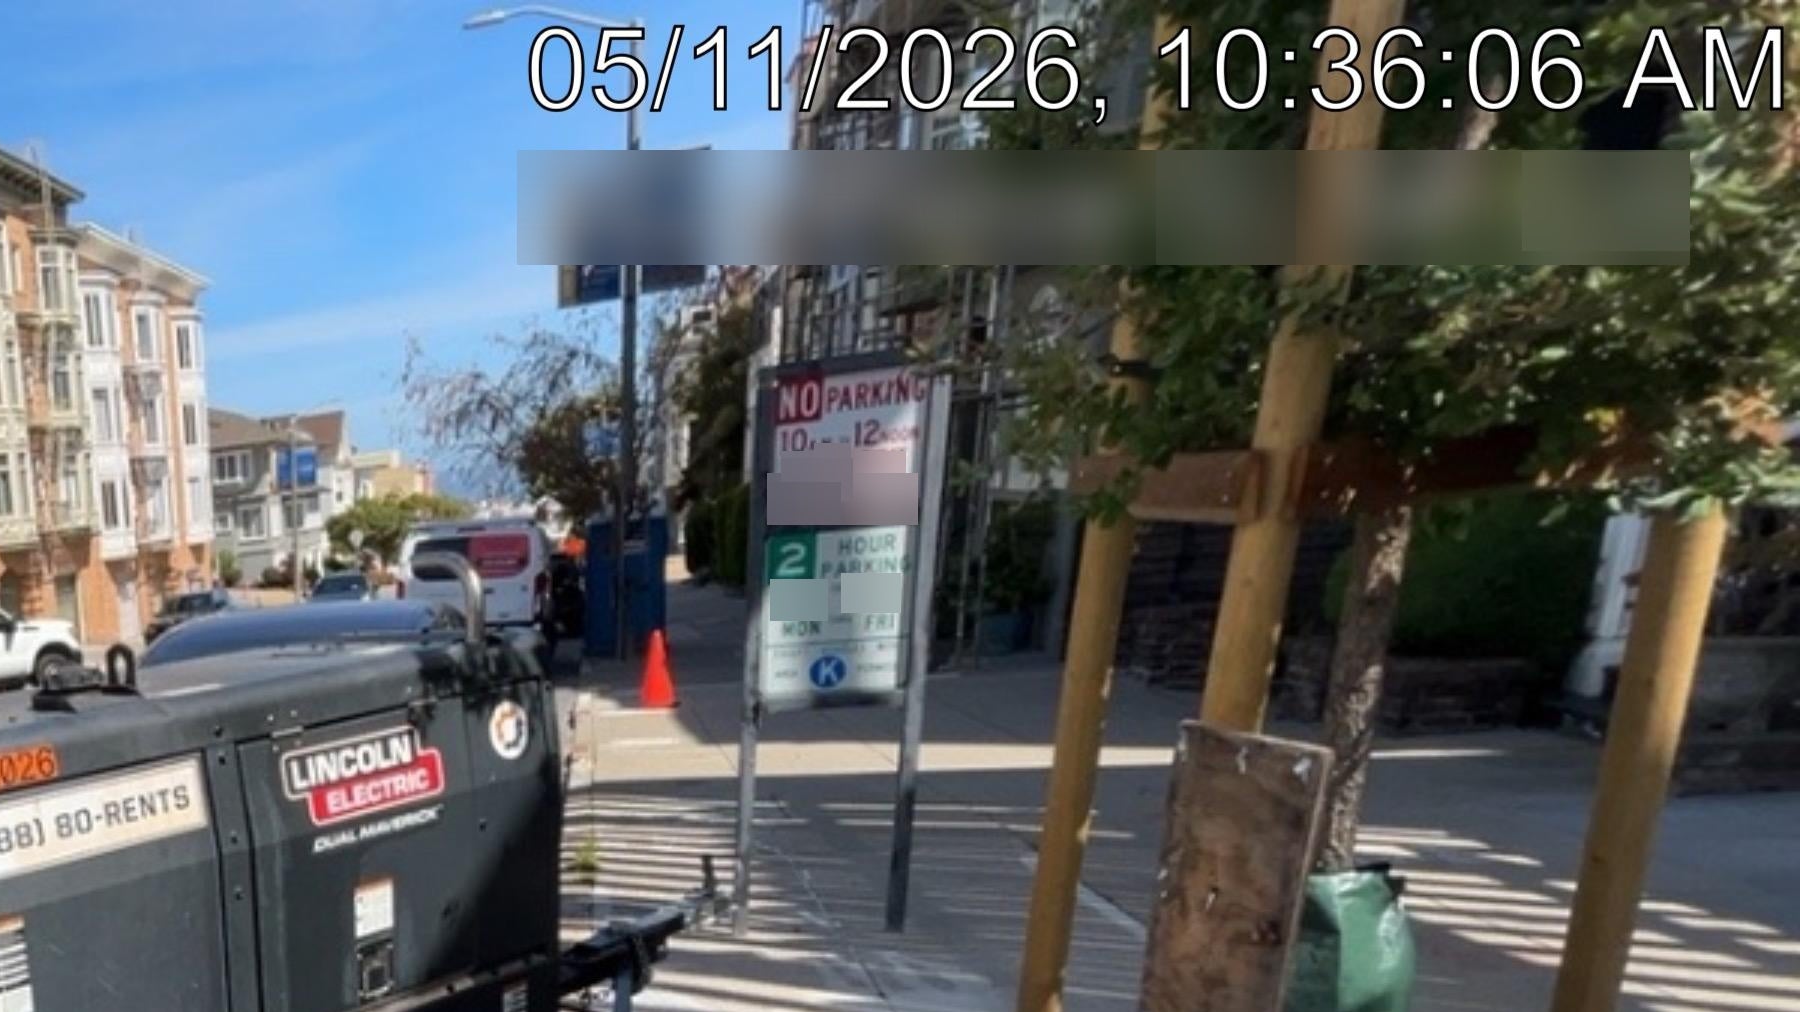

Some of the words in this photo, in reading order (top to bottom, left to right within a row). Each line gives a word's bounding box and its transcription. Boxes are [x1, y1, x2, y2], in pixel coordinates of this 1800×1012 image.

[778, 380, 820, 421] NO
[827, 372, 926, 412] PARKING
[776, 541, 806, 577] 2
[838, 533, 896, 556] HOUR
[822, 554, 912, 578] PARKING
[783, 620, 821, 637] MON
[865, 614, 895, 631] FRI
[818, 656, 838, 685] K
[290, 733, 413, 790] LINCOLN
[54, 783, 191, 841] 80-RENTS
[325, 767, 431, 815] ELECTRIC
[312, 830, 358, 853] DUAL
